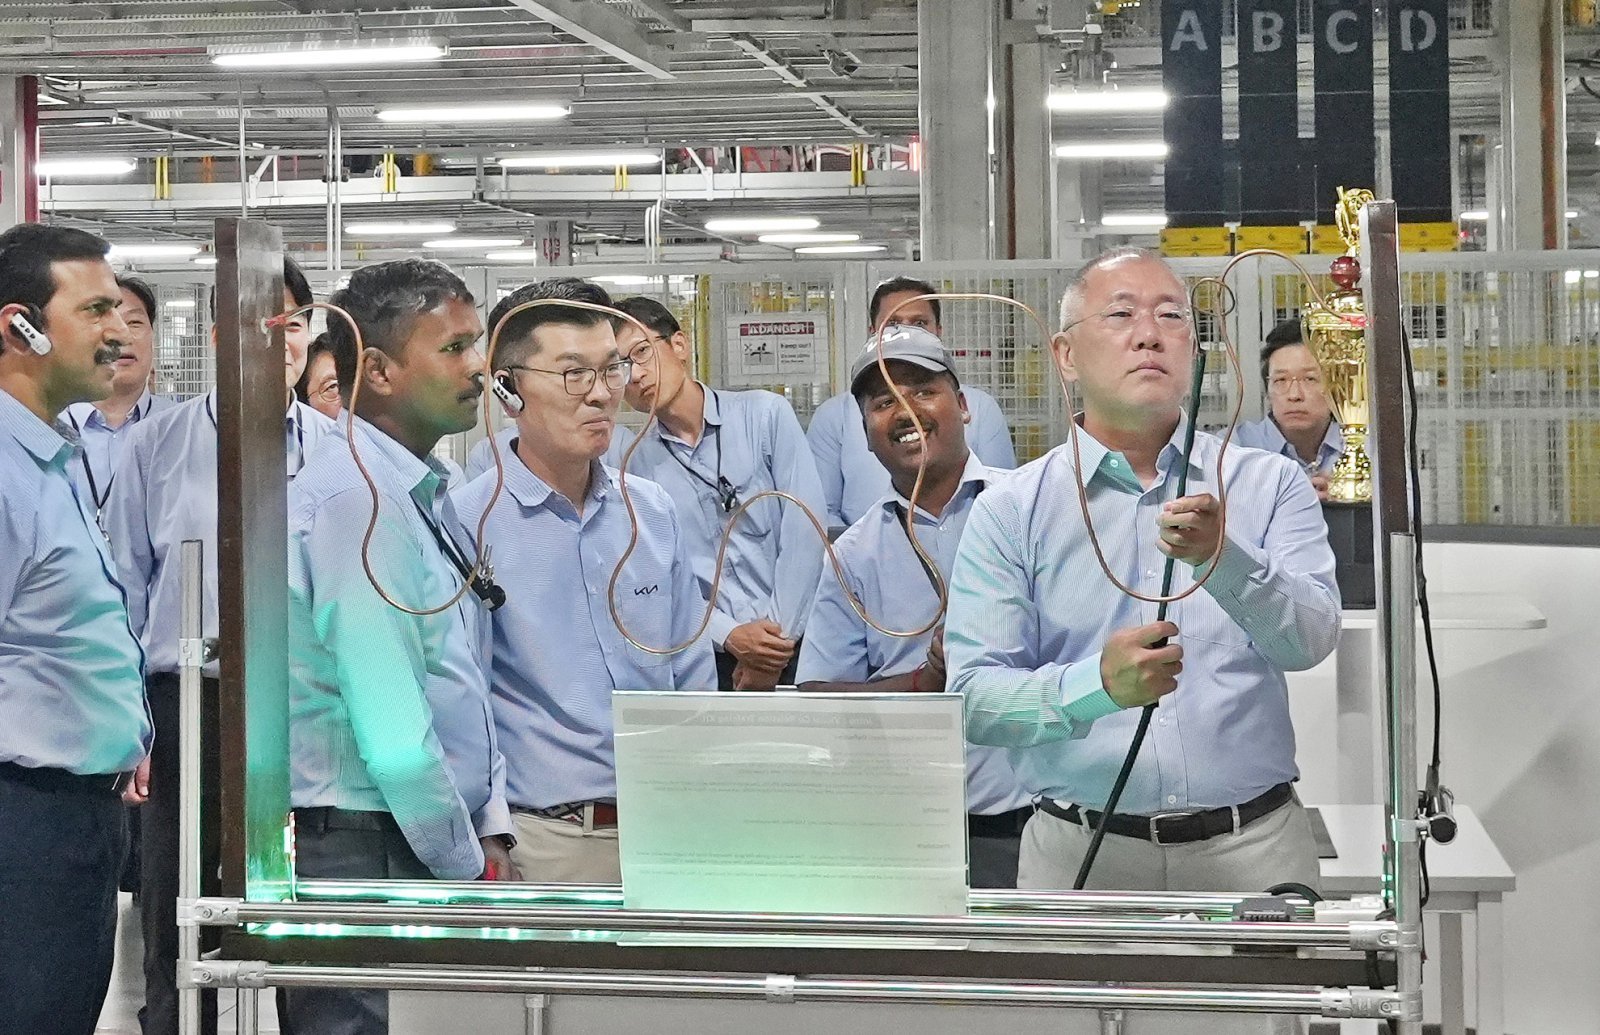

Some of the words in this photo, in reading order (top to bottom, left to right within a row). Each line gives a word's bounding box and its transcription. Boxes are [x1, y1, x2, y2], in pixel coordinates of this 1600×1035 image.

[1170, 9, 1208, 50] A
[1252, 11, 1284, 52] B
[1325, 9, 1358, 54] C
[1400, 9, 1437, 51] D
[760, 322, 805, 334] DANGER
